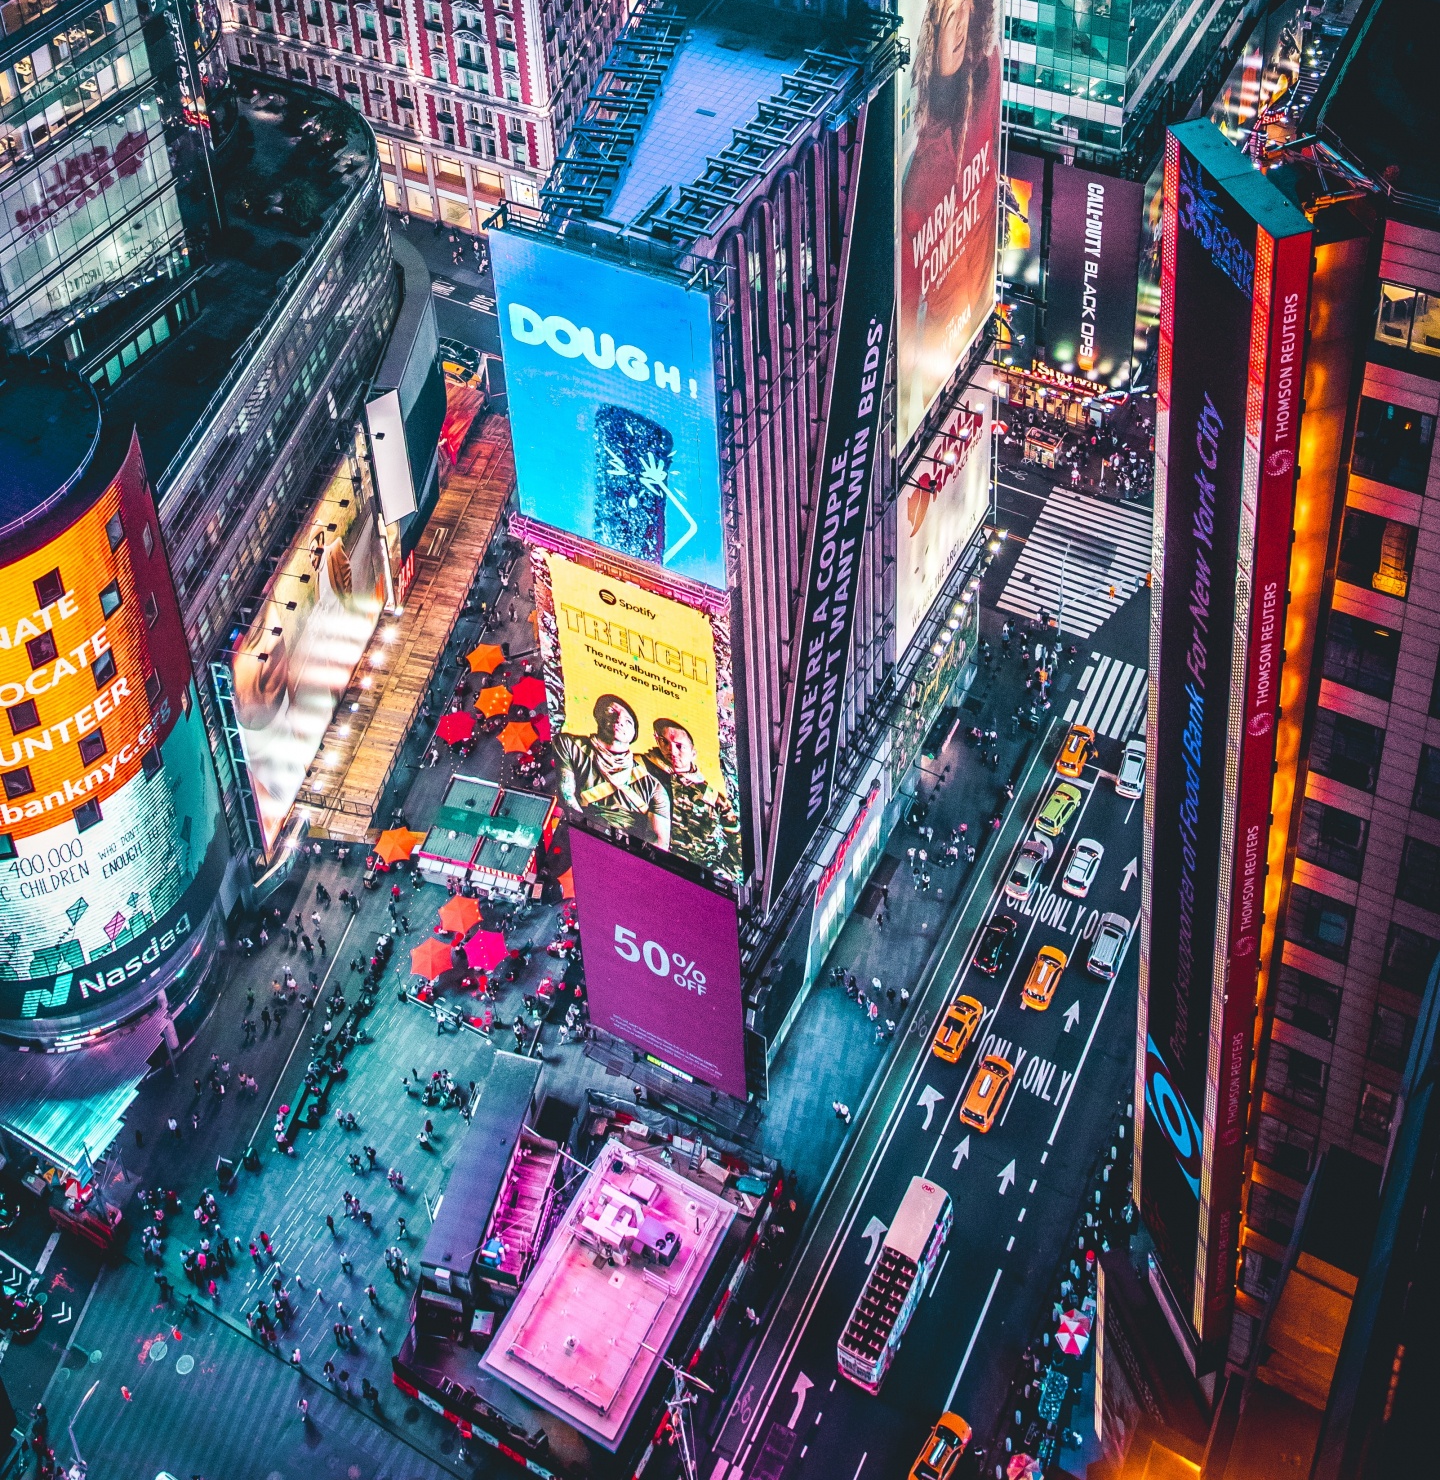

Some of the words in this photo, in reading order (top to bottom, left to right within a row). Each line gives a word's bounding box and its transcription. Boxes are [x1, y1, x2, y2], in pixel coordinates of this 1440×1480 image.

[962, 139, 990, 203] DRY.
[1086, 182, 1105, 216] CALL
[1084, 217, 1103, 259] DUTY
[1080, 260, 1099, 321] BLACK
[1079, 323, 1096, 358] OPS
[1280, 293, 1299, 365] REUTERS
[1196, 390, 1224, 471] City
[1275, 366, 1294, 443] THOMSON
[843, 426, 870, 525] TWIN
[816, 438, 851, 592] COUPLE.
[1193, 469, 1216, 551] York
[618, 598, 657, 620] Spotify
[812, 595, 831, 624] A
[828, 537, 856, 648] WANT
[1189, 548, 1213, 635] New
[1261, 581, 1278, 641] REUTERS
[560, 602, 709, 686] TRENCH
[584, 643, 604, 658] The
[605, 654, 627, 668] new
[629, 661, 661, 682] album
[662, 676, 688, 693] from
[593, 658, 629, 680] twenty
[1186, 627, 1208, 690] For
[1256, 642, 1273, 708] THOMSON
[815, 651, 841, 756] DON'T
[1182, 681, 1205, 768] Bank
[806, 757, 828, 820] WE
[1178, 752, 1200, 827] Food
[8, 836, 84, 880] 400,000
[97, 841, 117, 861] WHO
[102, 841, 143, 880] ENOUGH
[1178, 822, 1198, 872] of
[1245, 824, 1260, 877] REUTERS
[20, 862, 91, 900] CHILDREN
[1240, 877, 1255, 932] THOMSON
[1040, 893, 1087, 936] ONLY
[78, 911, 192, 1000] Nasdaq
[673, 973, 708, 997] OFF
[1022, 1055, 1073, 1107] ONLY
[1230, 1031, 1245, 1078] REUTERS
[1227, 1077, 1241, 1126] THOMSON
[1218, 1210, 1231, 1250] REUTERS
[1215, 1249, 1228, 1292] THOMSON
